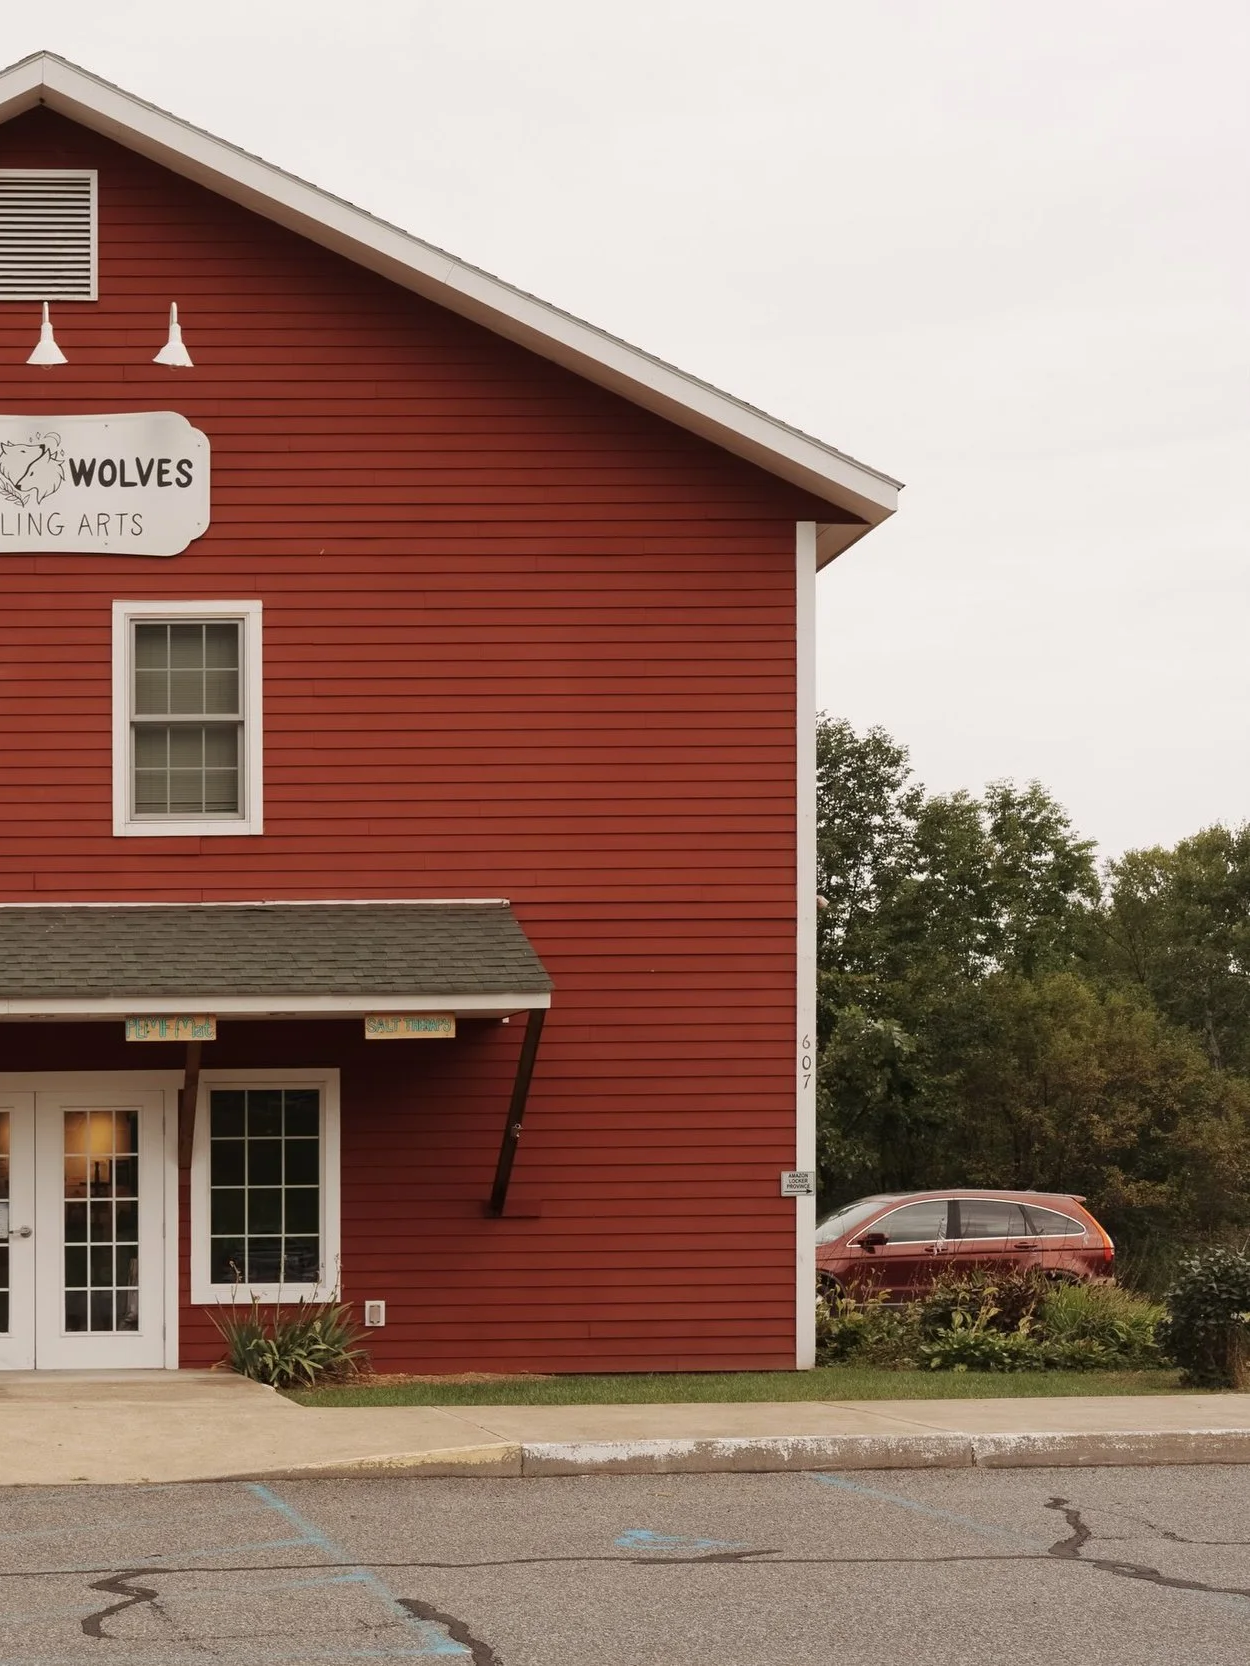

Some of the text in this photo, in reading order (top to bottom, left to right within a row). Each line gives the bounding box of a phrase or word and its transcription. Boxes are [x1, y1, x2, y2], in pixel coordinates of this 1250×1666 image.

[68, 457, 193, 488] WOLVES
[77, 512, 143, 536] ARTS
[175, 1016, 214, 1038] Mat
[366, 1017, 401, 1033] SALT
[801, 1033, 812, 1090] 607
